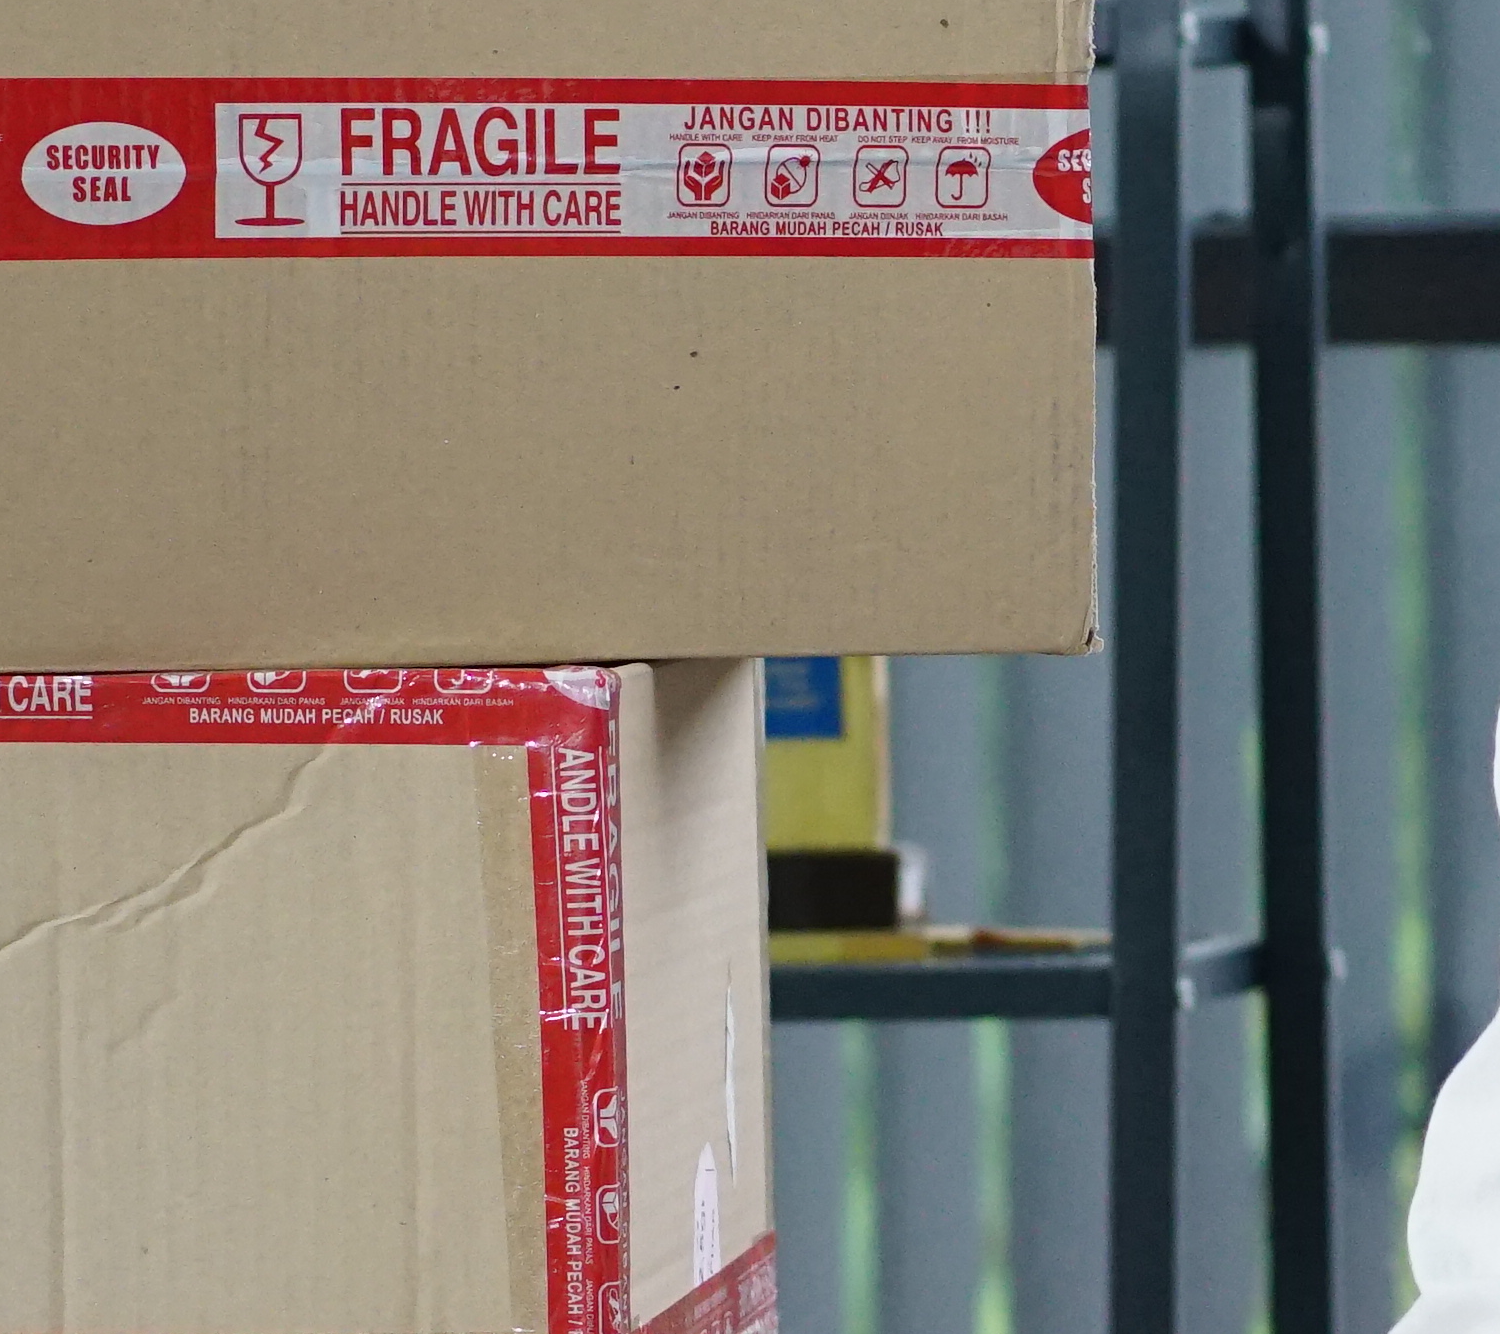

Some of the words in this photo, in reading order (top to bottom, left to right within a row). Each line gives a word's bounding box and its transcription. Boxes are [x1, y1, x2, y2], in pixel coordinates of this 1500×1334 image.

[669, 133, 700, 143] HANDLE
[701, 133, 721, 143] WITH
[722, 133, 743, 143] CARE
[752, 133, 772, 143] KEEP
[773, 133, 794, 143] AWAY
[796, 133, 817, 143] FROM
[819, 133, 838, 143] HEAT
[684, 106, 794, 133] JANGAN
[806, 106, 953, 133] DIBANTING
[46, 144, 161, 171] SECURITY
[340, 106, 622, 176] FRAGILE
[72, 176, 132, 202] SEAL
[340, 189, 457, 227] HANDLE
[463, 189, 535, 227] WITH
[542, 189, 622, 227] CARE
[710, 220, 770, 237] BARANG
[775, 220, 827, 237] MUDAH
[832, 220, 882, 237] PECAH
[895, 220, 943, 237] RUSAK
[8, 675, 94, 713] CARE
[189, 708, 255, 725] BARANG
[260, 708, 316, 725] MUDAH
[322, 708, 374, 725] PECAH
[390, 708, 444, 725] RUSAK
[564, 857, 603, 936] WITH
[568, 944, 609, 1031] CARE
[563, 1126, 581, 1193] BARANG
[565, 1198, 582, 1255] MUDAH
[566, 1260, 583, 1316] PECAH
